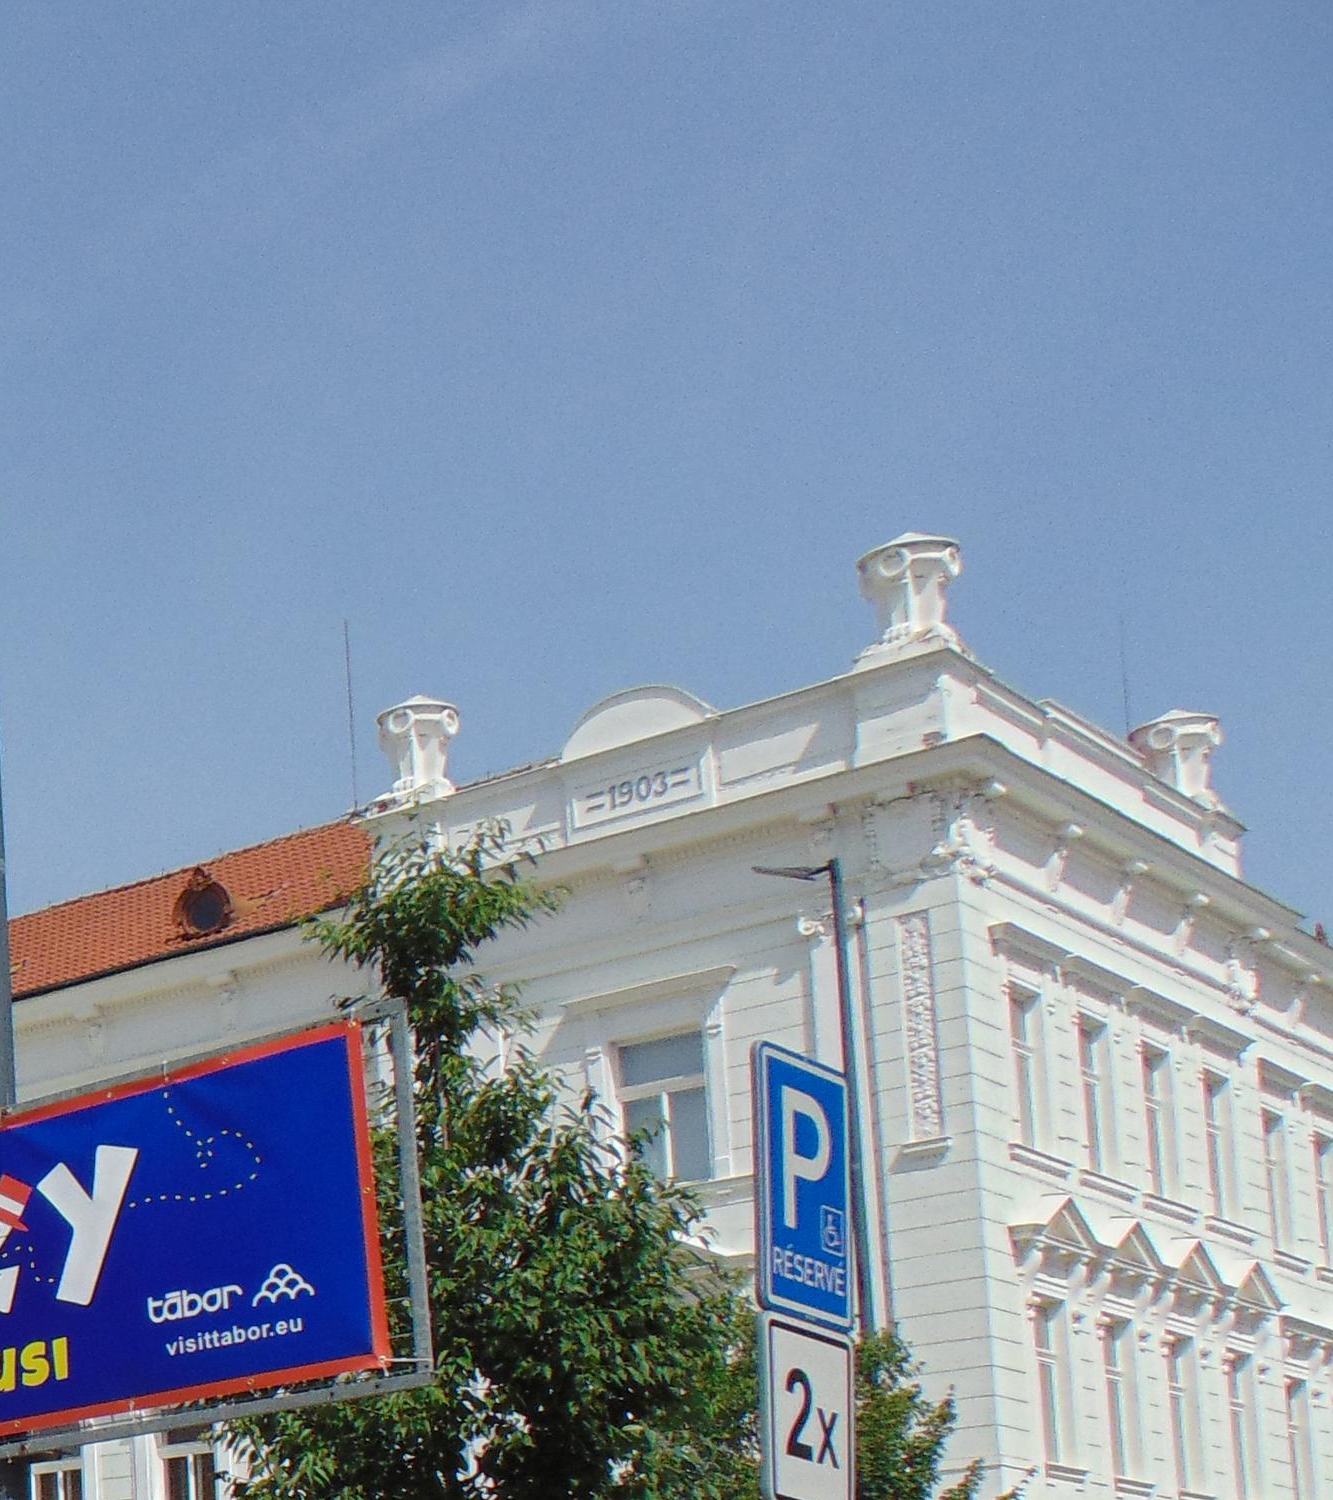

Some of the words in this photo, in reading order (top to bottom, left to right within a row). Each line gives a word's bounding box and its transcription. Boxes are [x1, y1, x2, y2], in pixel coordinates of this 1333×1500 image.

[782, 1085, 832, 1230] P
[773, 1243, 846, 1297] RÉSERVÉ
[165, 1317, 304, 1356] visittabor.eu
[785, 1367, 840, 1470] 2x
